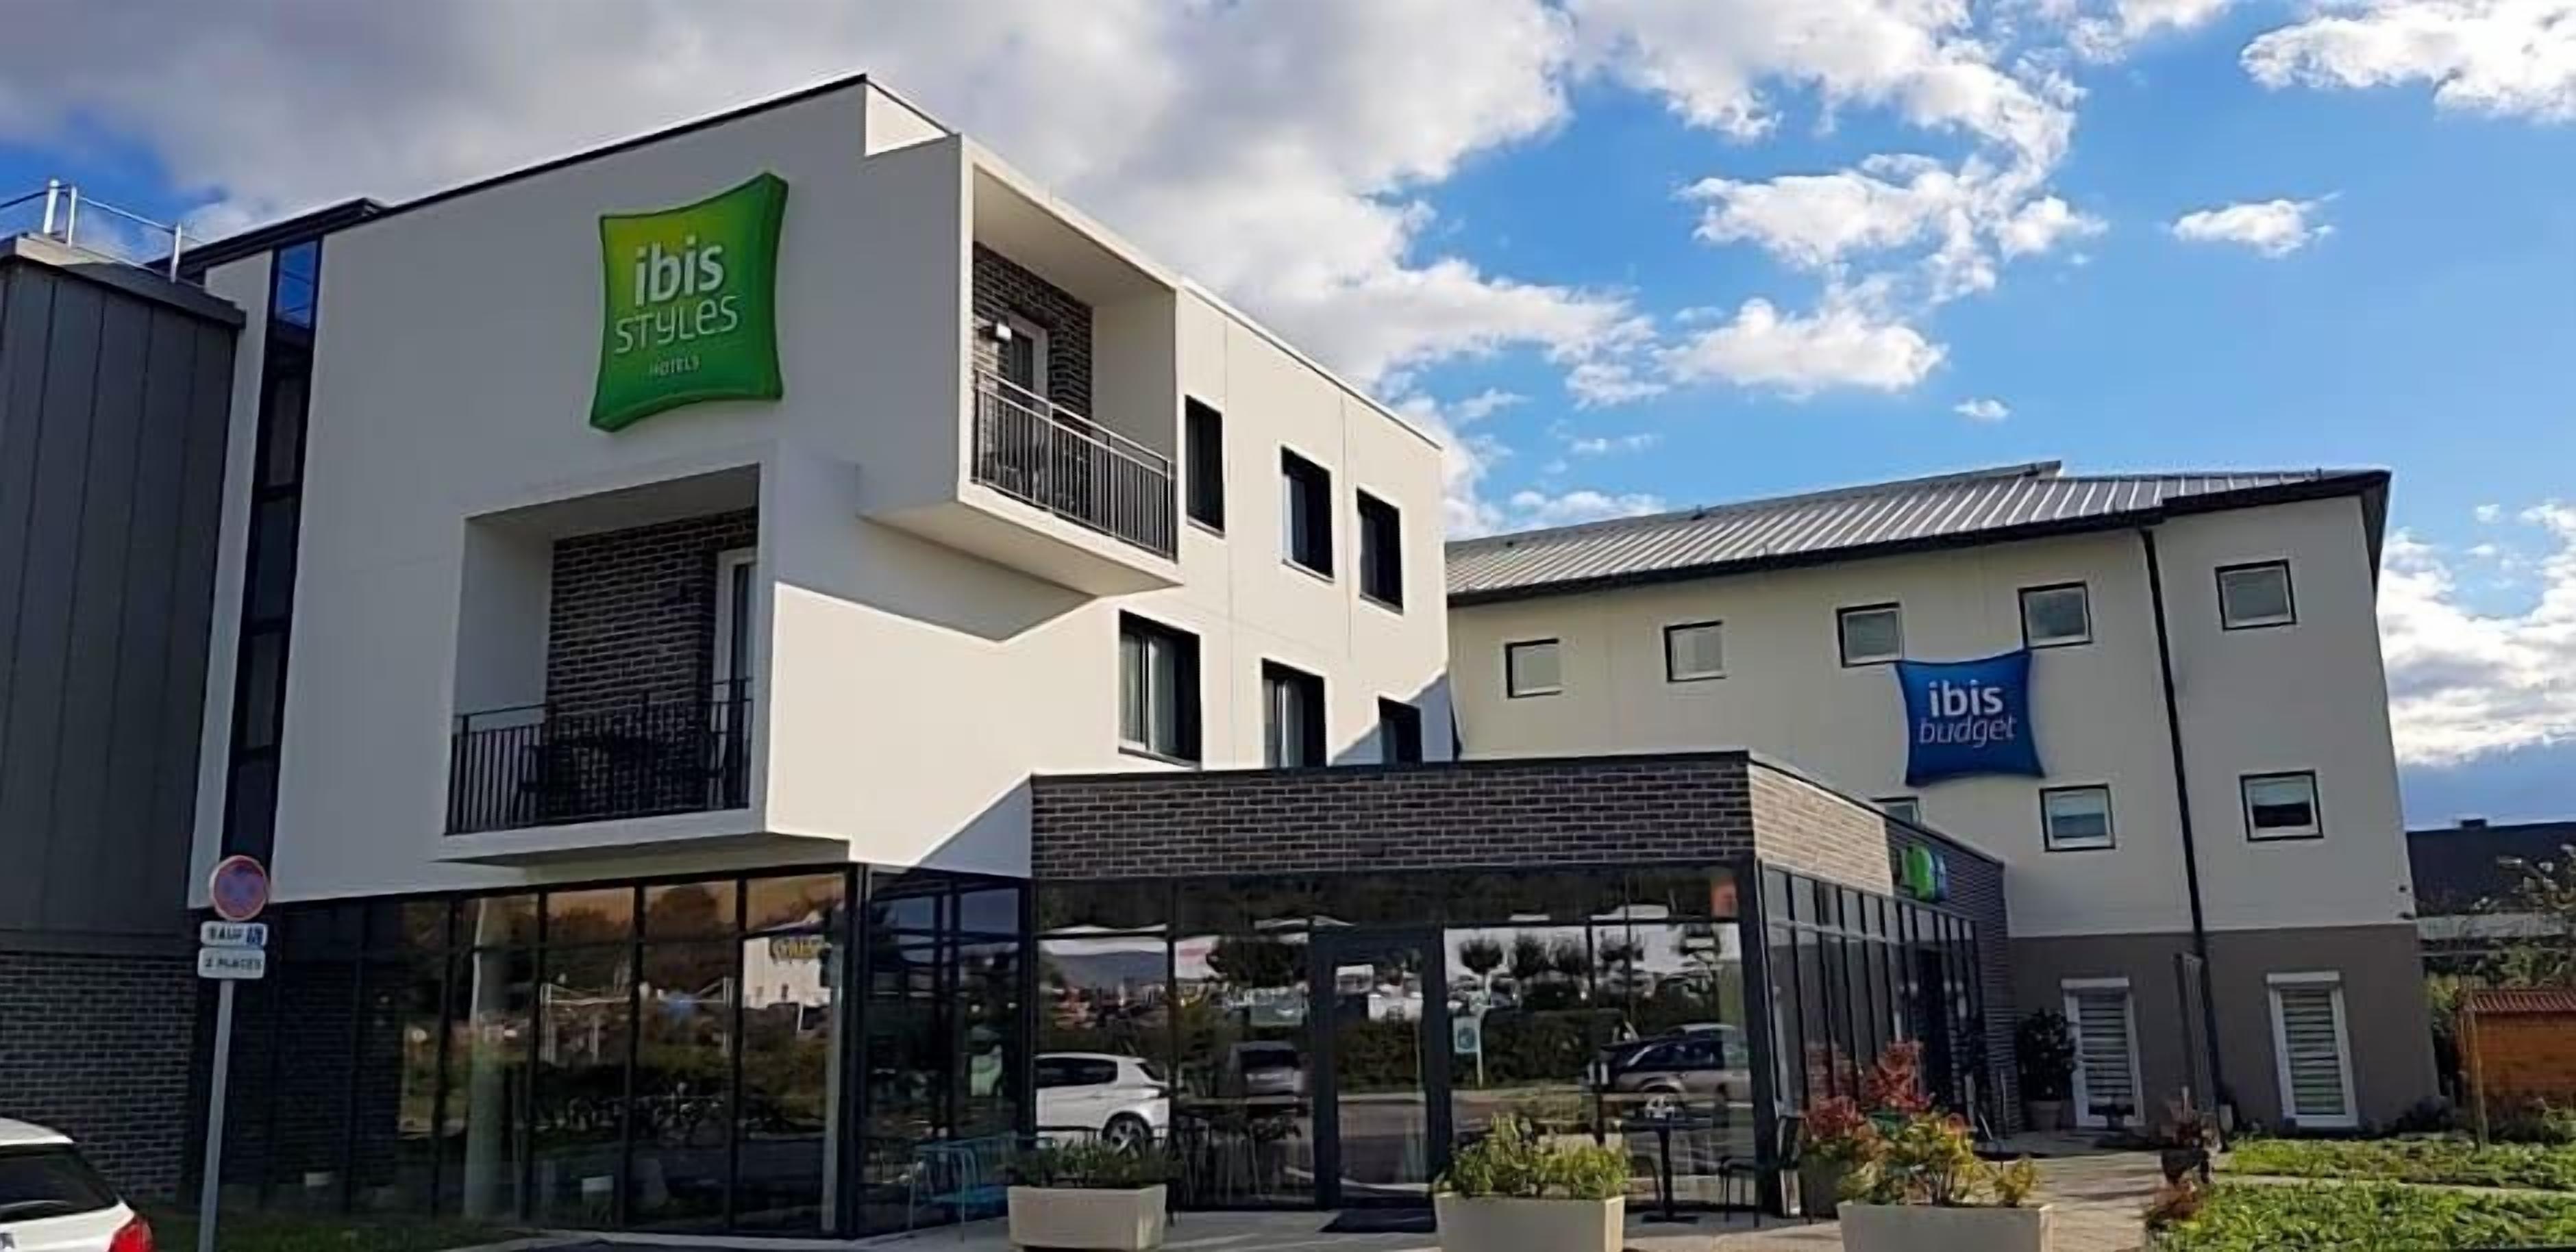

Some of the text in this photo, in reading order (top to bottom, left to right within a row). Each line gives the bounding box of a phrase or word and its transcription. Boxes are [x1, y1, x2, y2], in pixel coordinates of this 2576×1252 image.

[634, 234, 725, 307] ibis
[1929, 679, 2003, 717] ibis
[1919, 715, 2017, 748] budget
